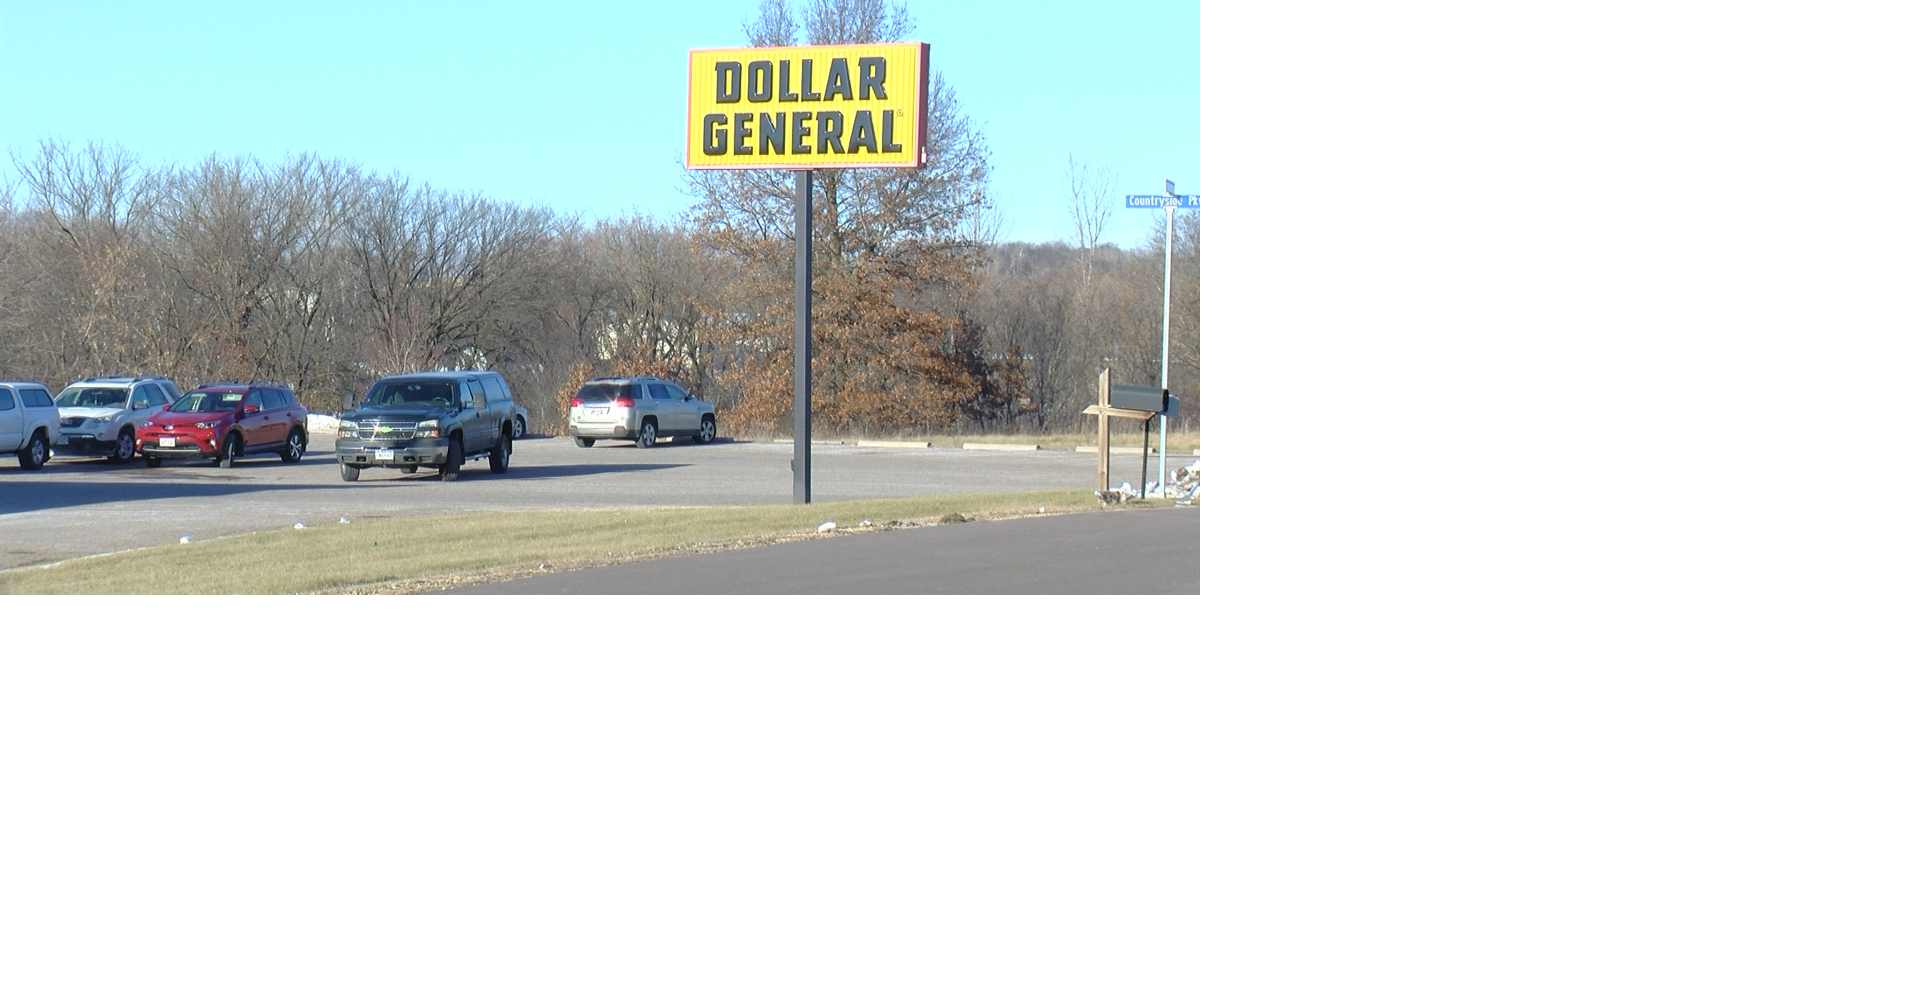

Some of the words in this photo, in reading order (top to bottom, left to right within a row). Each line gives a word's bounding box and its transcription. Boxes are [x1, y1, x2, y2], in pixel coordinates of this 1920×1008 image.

[714, 56, 889, 104] DOLLAR
[702, 109, 903, 156] GENERAL
[1129, 195, 1183, 208] Countryside
